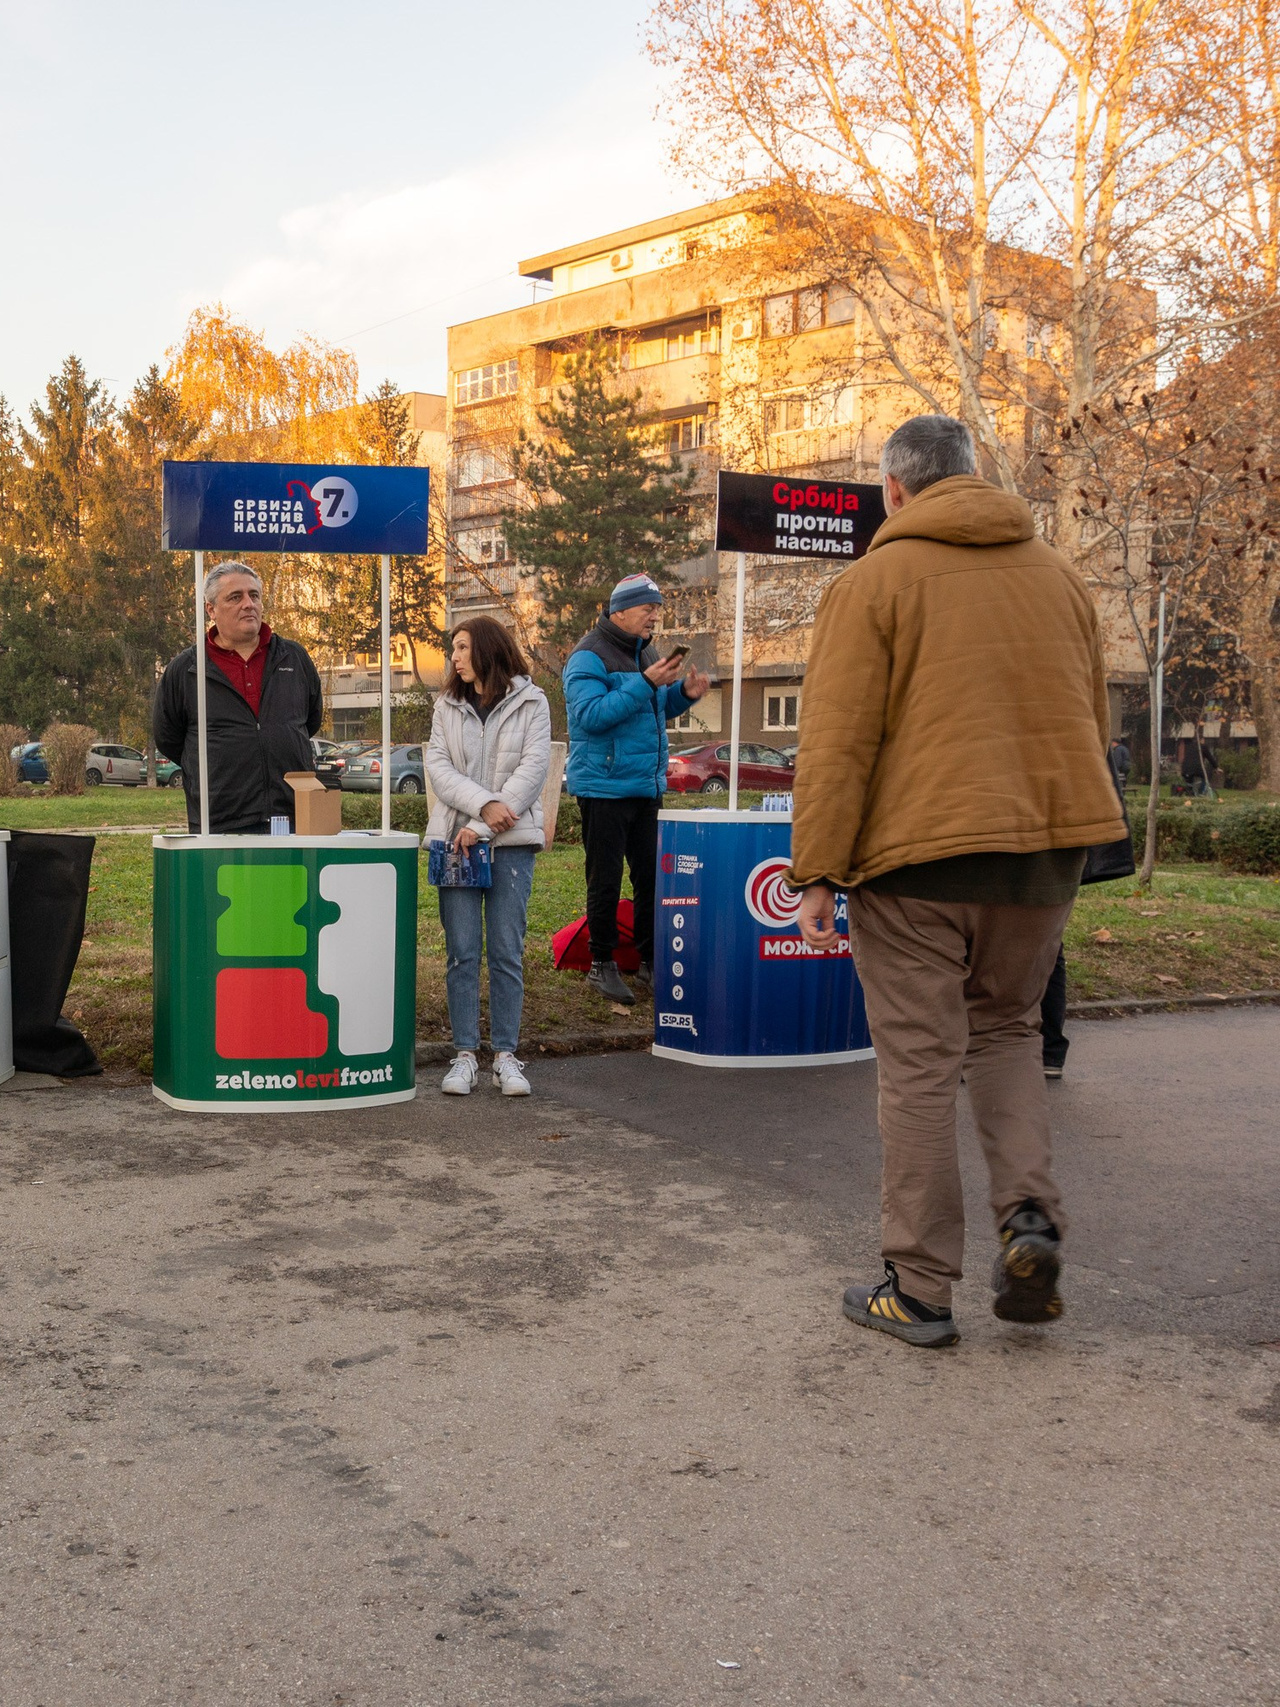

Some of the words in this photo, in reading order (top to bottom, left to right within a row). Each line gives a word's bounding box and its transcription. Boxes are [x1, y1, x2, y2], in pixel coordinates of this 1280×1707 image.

[234, 499, 304, 512] СРБИЈА
[323, 489, 349, 517] 7.
[772, 482, 859, 514] Србија
[234, 511, 303, 523] ПРОТИВ
[776, 513, 854, 534] против
[234, 522, 307, 534] НАСИЉА
[775, 535, 854, 554] насиља
[661, 1015, 691, 1026] SSP.RS
[215, 1064, 393, 1090] zelenolevifront
